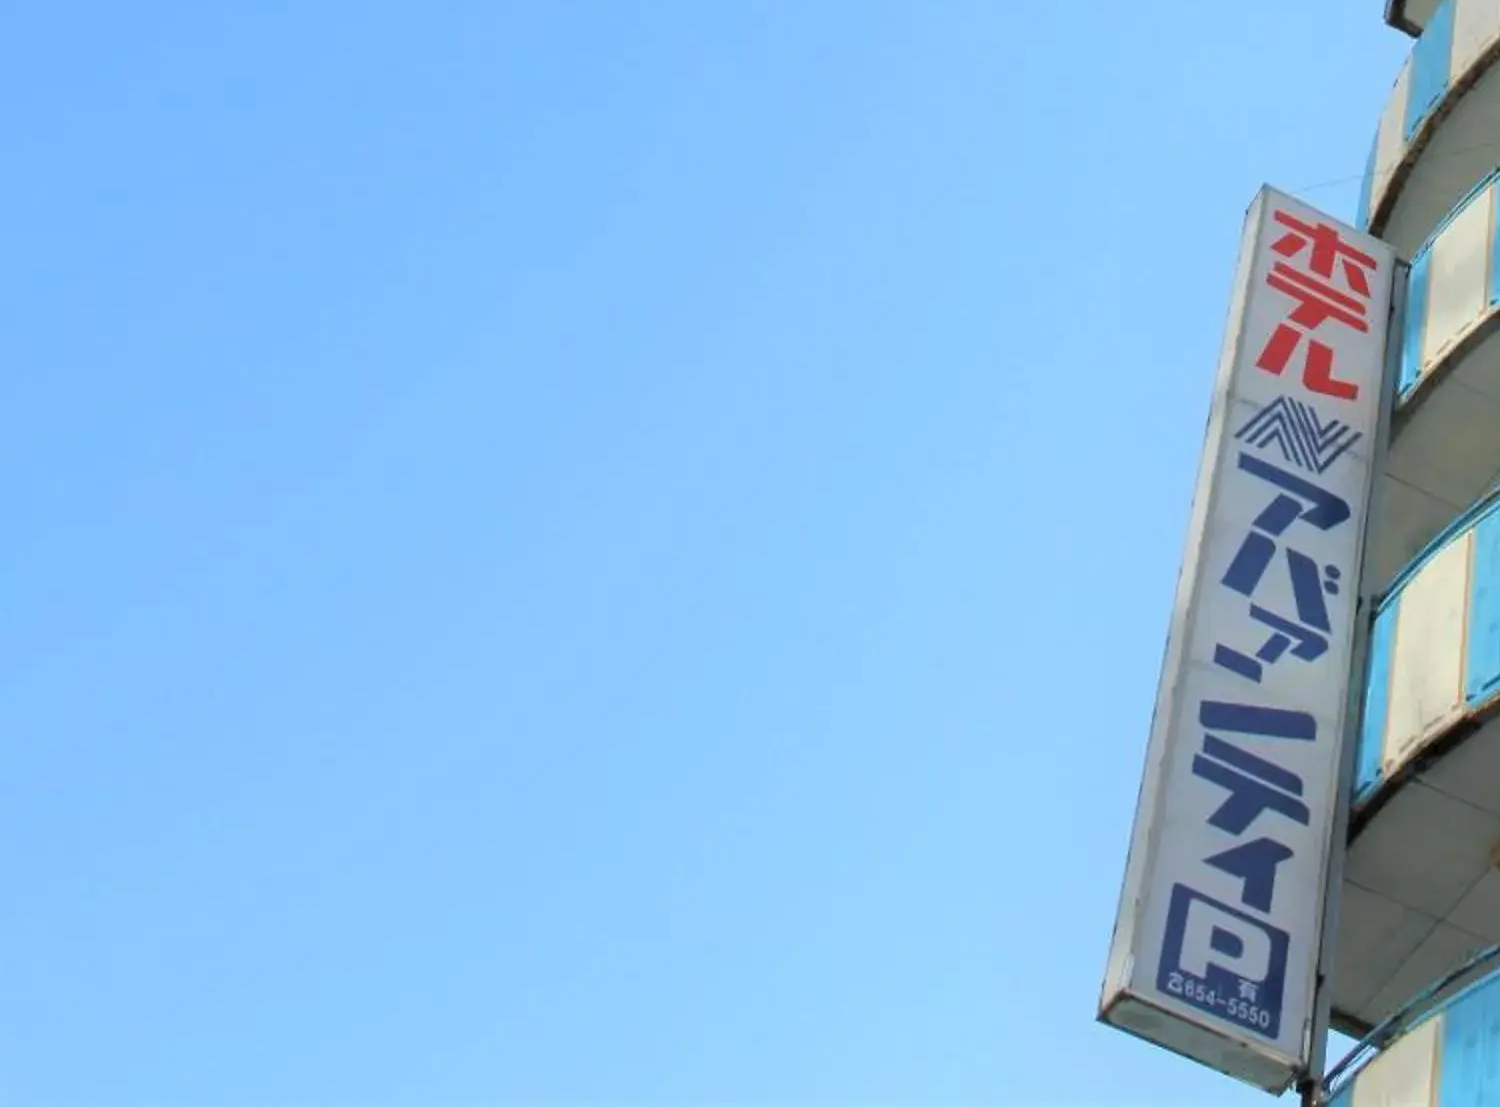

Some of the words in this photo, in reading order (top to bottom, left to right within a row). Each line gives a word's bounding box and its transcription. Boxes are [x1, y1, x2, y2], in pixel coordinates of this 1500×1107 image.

[1256, 210, 1377, 401] ホテル
[1179, 898, 1271, 982] P
